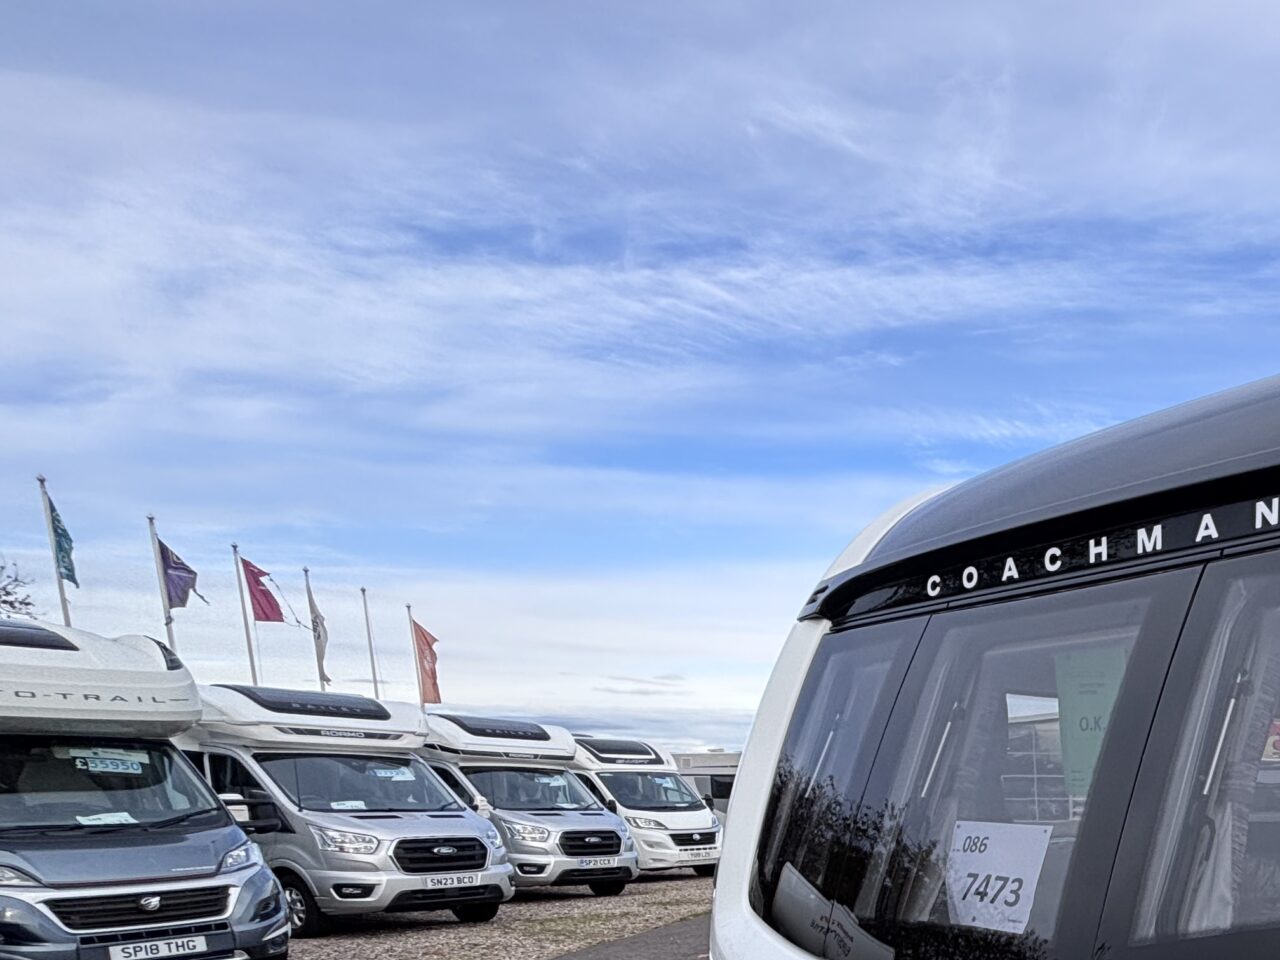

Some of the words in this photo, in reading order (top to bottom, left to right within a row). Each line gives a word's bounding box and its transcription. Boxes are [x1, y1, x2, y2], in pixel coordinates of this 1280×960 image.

[926, 497, 1280, 597] COACHMAN
[0, 688, 167, 704] O-TRAIL
[430, 877, 455, 887] SN23
[962, 872, 1024, 908] 7473
[121, 943, 160, 958] SP18
[164, 940, 197, 953] THG
